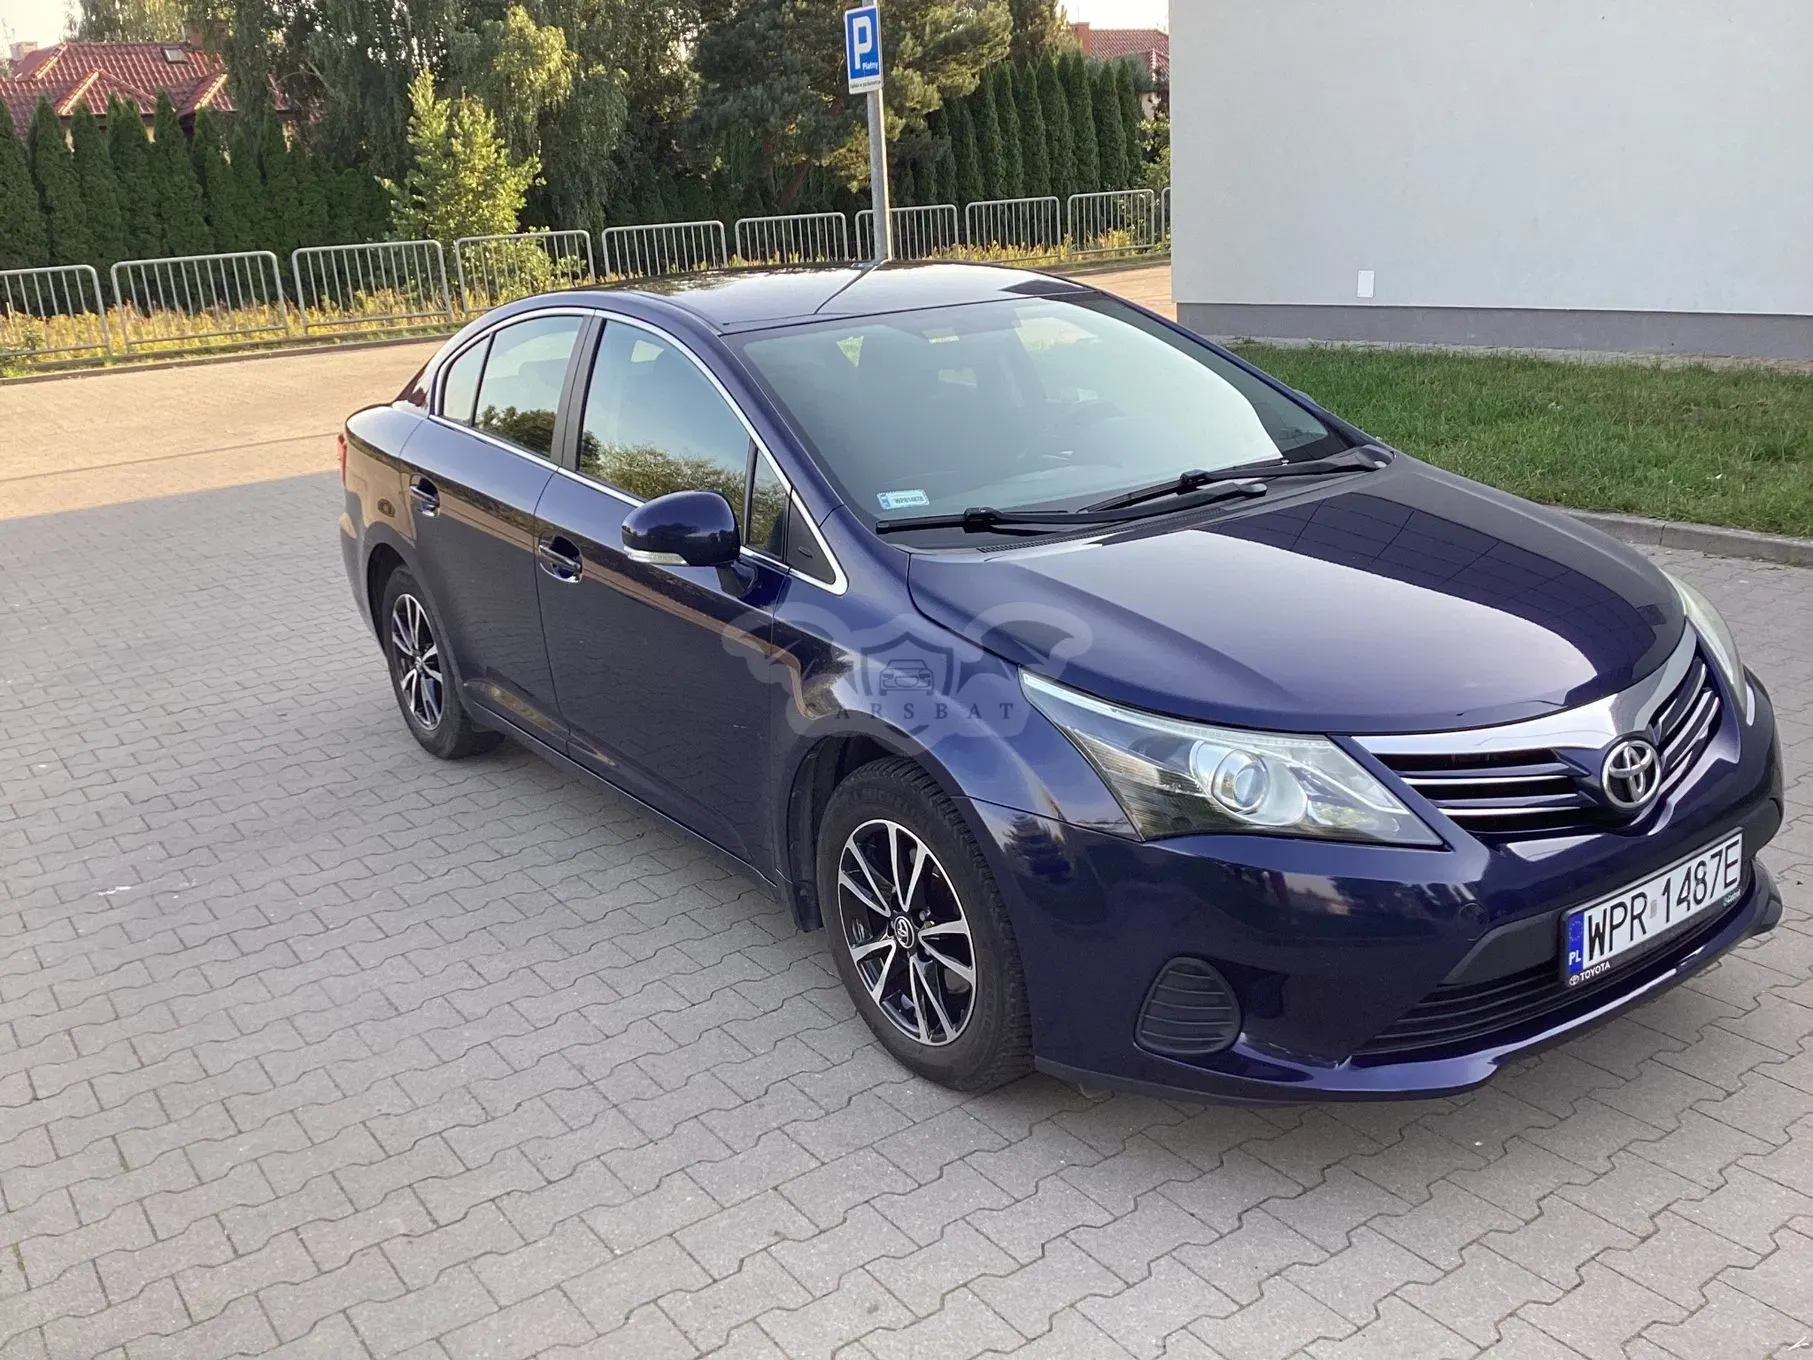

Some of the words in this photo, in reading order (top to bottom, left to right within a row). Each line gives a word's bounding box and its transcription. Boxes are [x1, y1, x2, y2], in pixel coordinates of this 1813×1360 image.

[853, 15, 873, 70] P
[1587, 891, 1648, 962] WPR
[1661, 839, 1740, 924] 1487E
[1568, 949, 1582, 966] PL
[1580, 960, 1611, 981] TOYOTA
